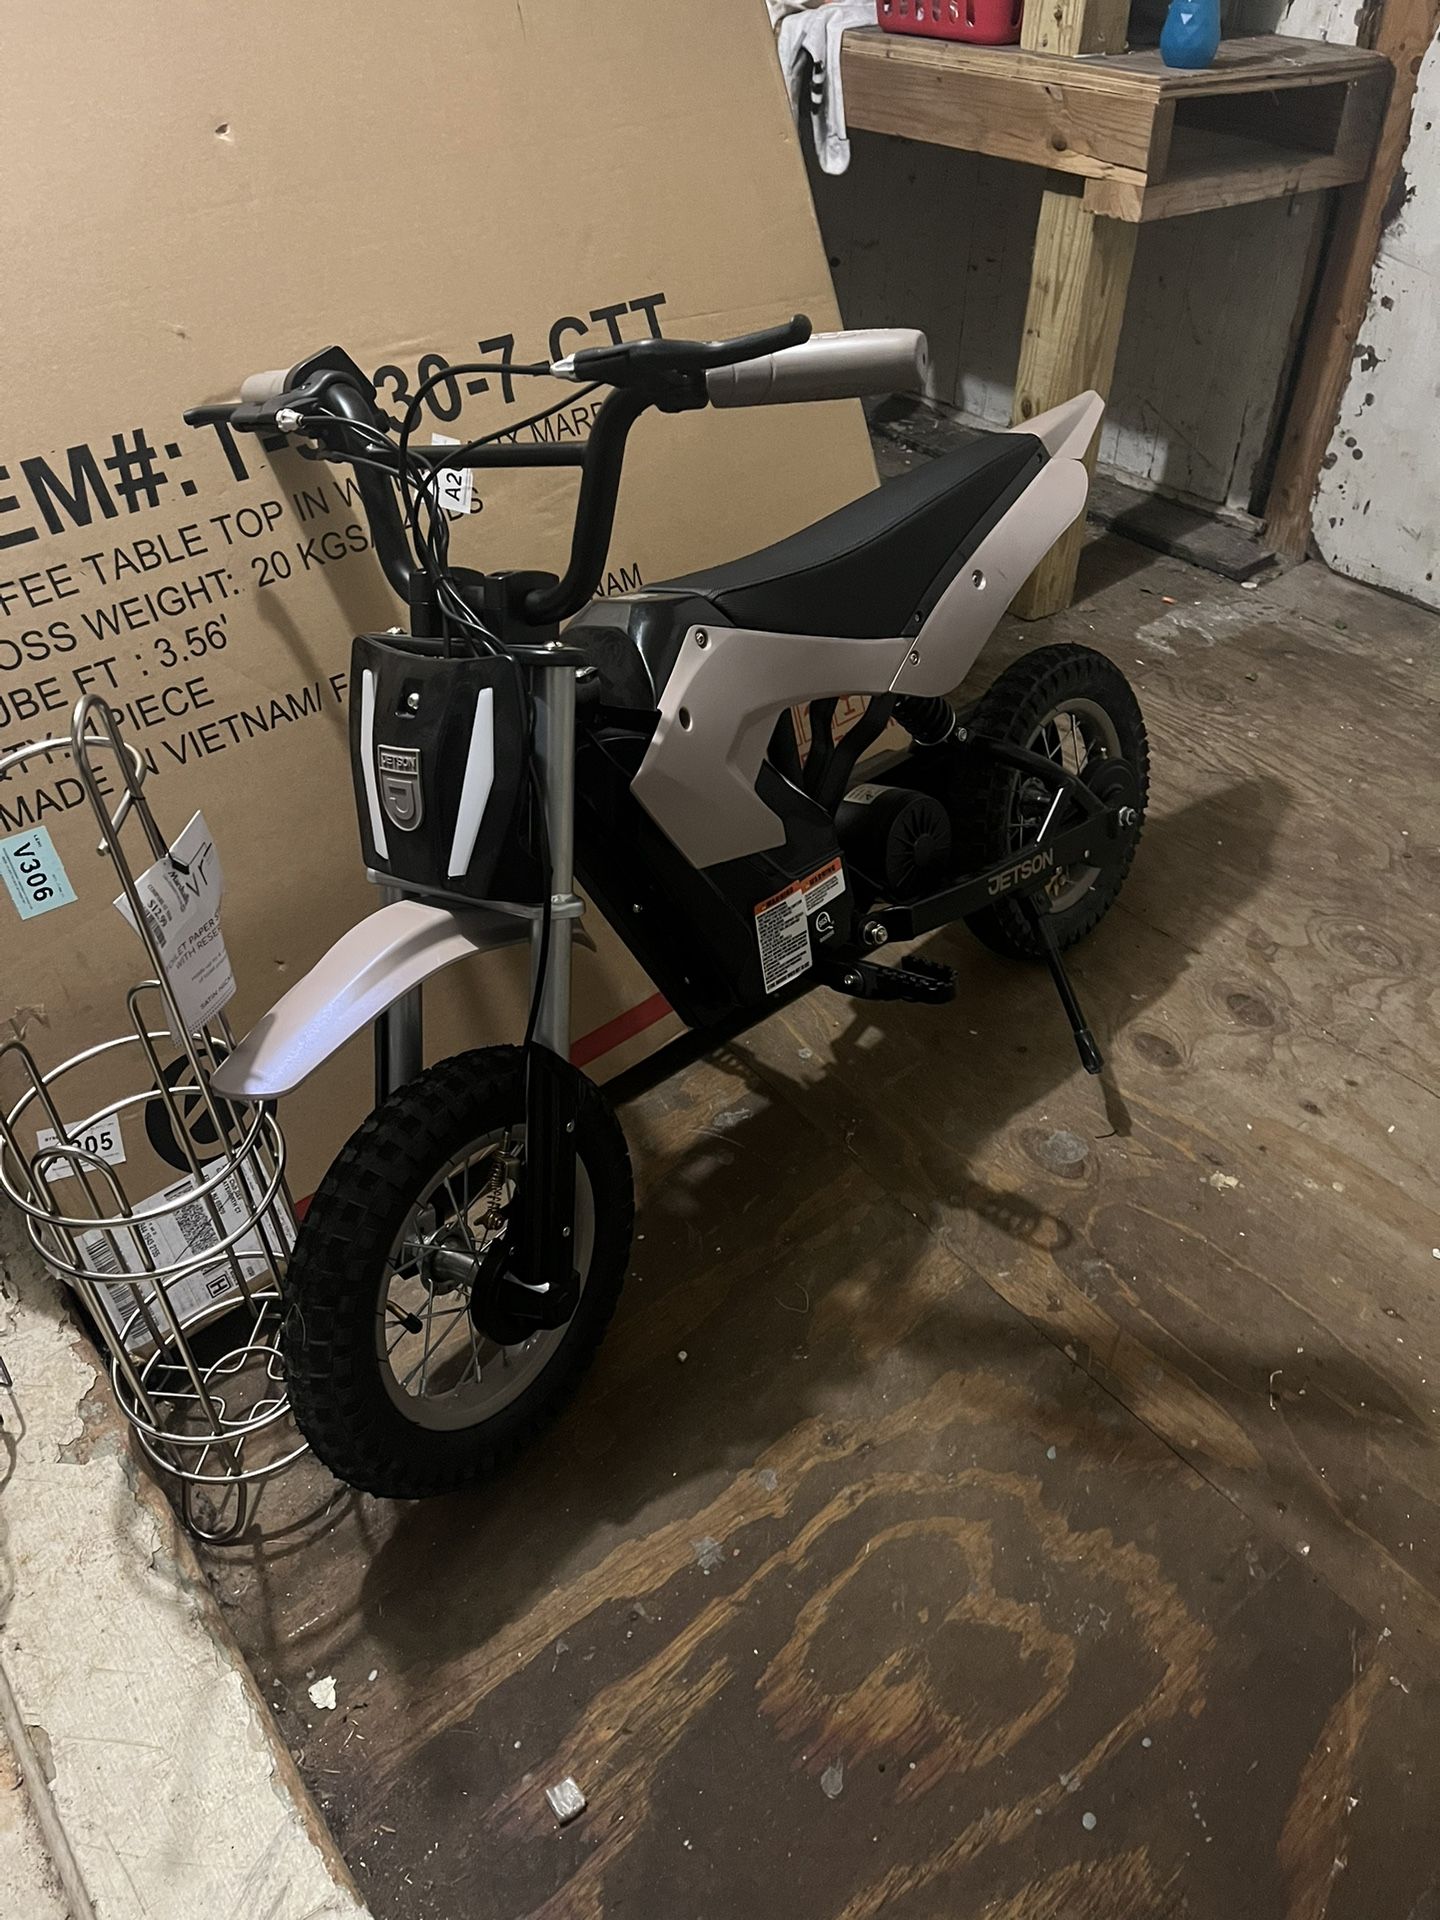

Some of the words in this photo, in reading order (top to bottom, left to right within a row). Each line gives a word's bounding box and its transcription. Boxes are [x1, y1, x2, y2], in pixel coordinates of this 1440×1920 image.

[81, 524, 208, 585] TABLE
[209, 500, 283, 545] TOP
[292, 486, 330, 521] IN
[81, 568, 239, 641] WEIGHT:
[251, 550, 292, 588] 20
[72, 656, 119, 695] FT
[381, 752, 418, 773] JETSON
[13, 841, 54, 902] V306
[987, 847, 1053, 896] JETSON
[188, 917, 216, 945] PAPER
